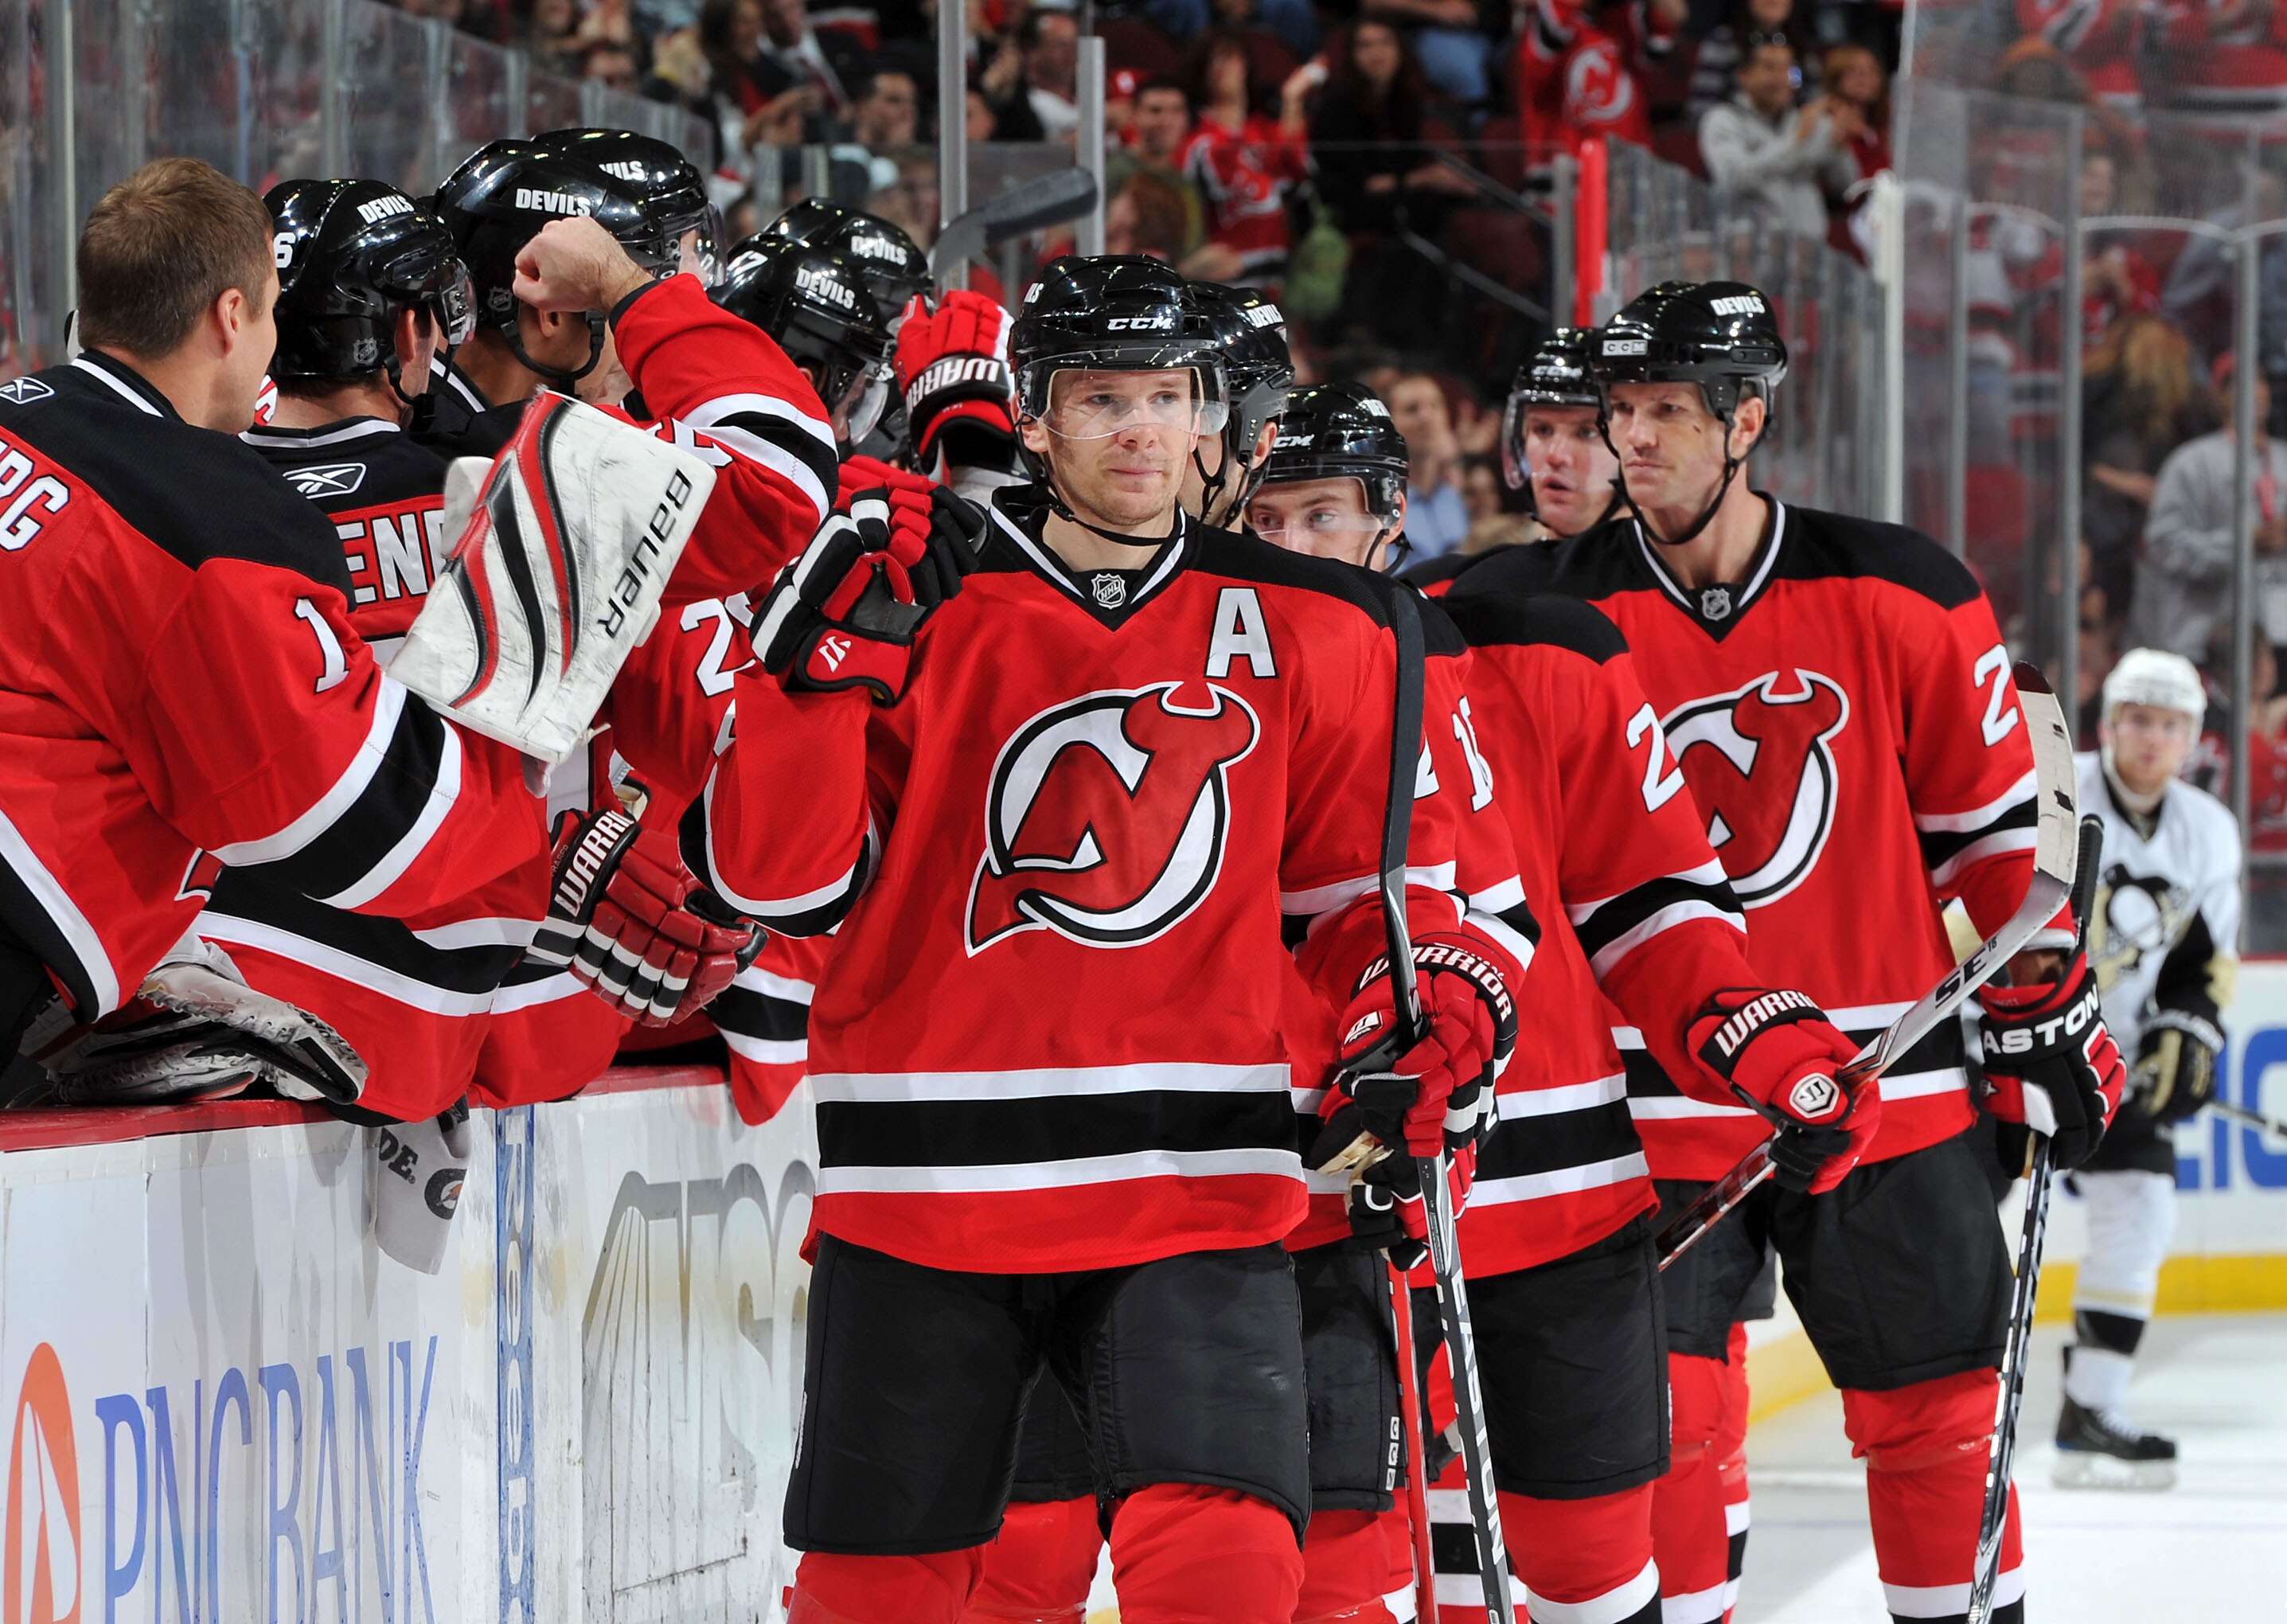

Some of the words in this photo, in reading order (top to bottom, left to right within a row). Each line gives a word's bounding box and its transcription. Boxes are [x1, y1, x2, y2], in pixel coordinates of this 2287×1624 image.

[357, 196, 415, 224] DEVILS
[516, 188, 591, 217] DEVILS
[851, 236, 907, 266] DEVILS
[795, 267, 856, 310] DEVILS
[1710, 295, 1766, 316] DEVILS
[1106, 317, 1175, 330] CCM
[1606, 341, 1647, 355] CCM
[294, 597, 349, 693] 1
[1204, 586, 1279, 679] A
[554, 809, 634, 917] WARRI
[1359, 946, 1512, 1024] WRRIOR
[1714, 990, 1820, 1058] WARRI
[505, 1115, 528, 1624] Reeb
[1450, 1266, 1505, 1566] EASTON
